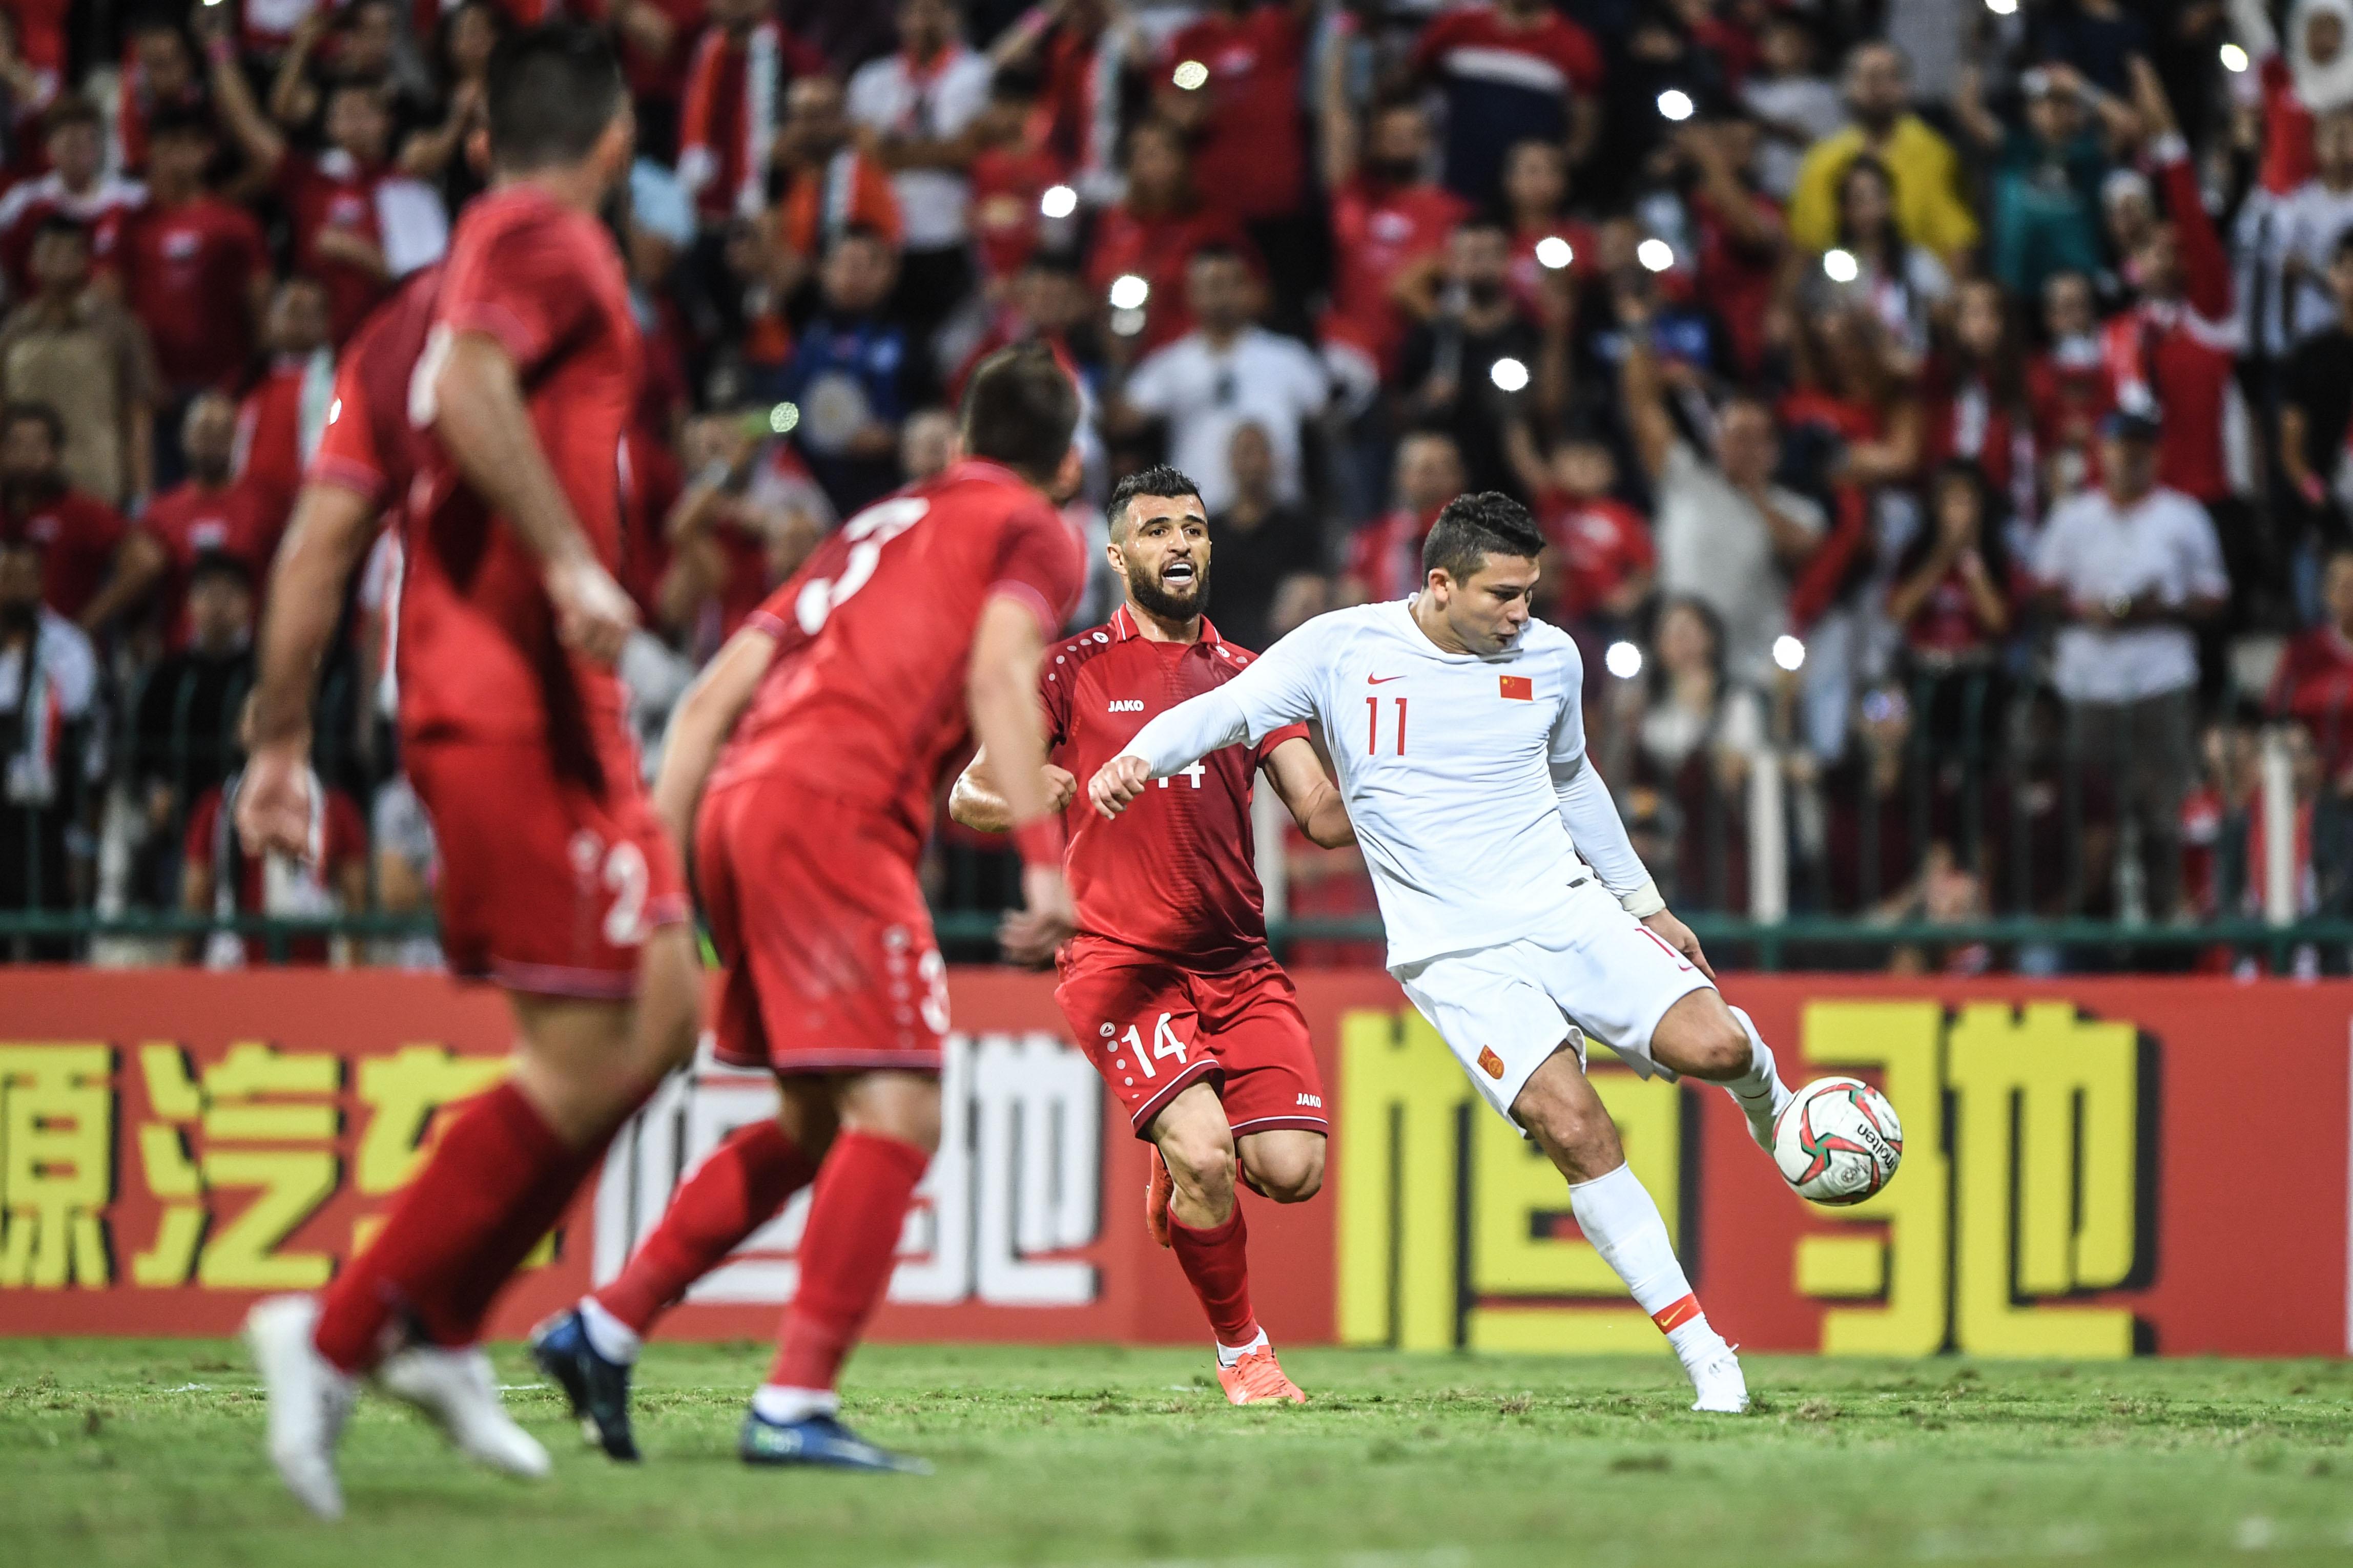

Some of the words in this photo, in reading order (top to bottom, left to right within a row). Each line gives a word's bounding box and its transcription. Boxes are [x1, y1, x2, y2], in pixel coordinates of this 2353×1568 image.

[1108, 700, 1144, 712] JAKO
[1366, 697, 1408, 756] 11
[1121, 1012, 1187, 1079] 14
[1296, 1092, 1322, 1109] JAKO
[1857, 1123, 1895, 1169] molten
